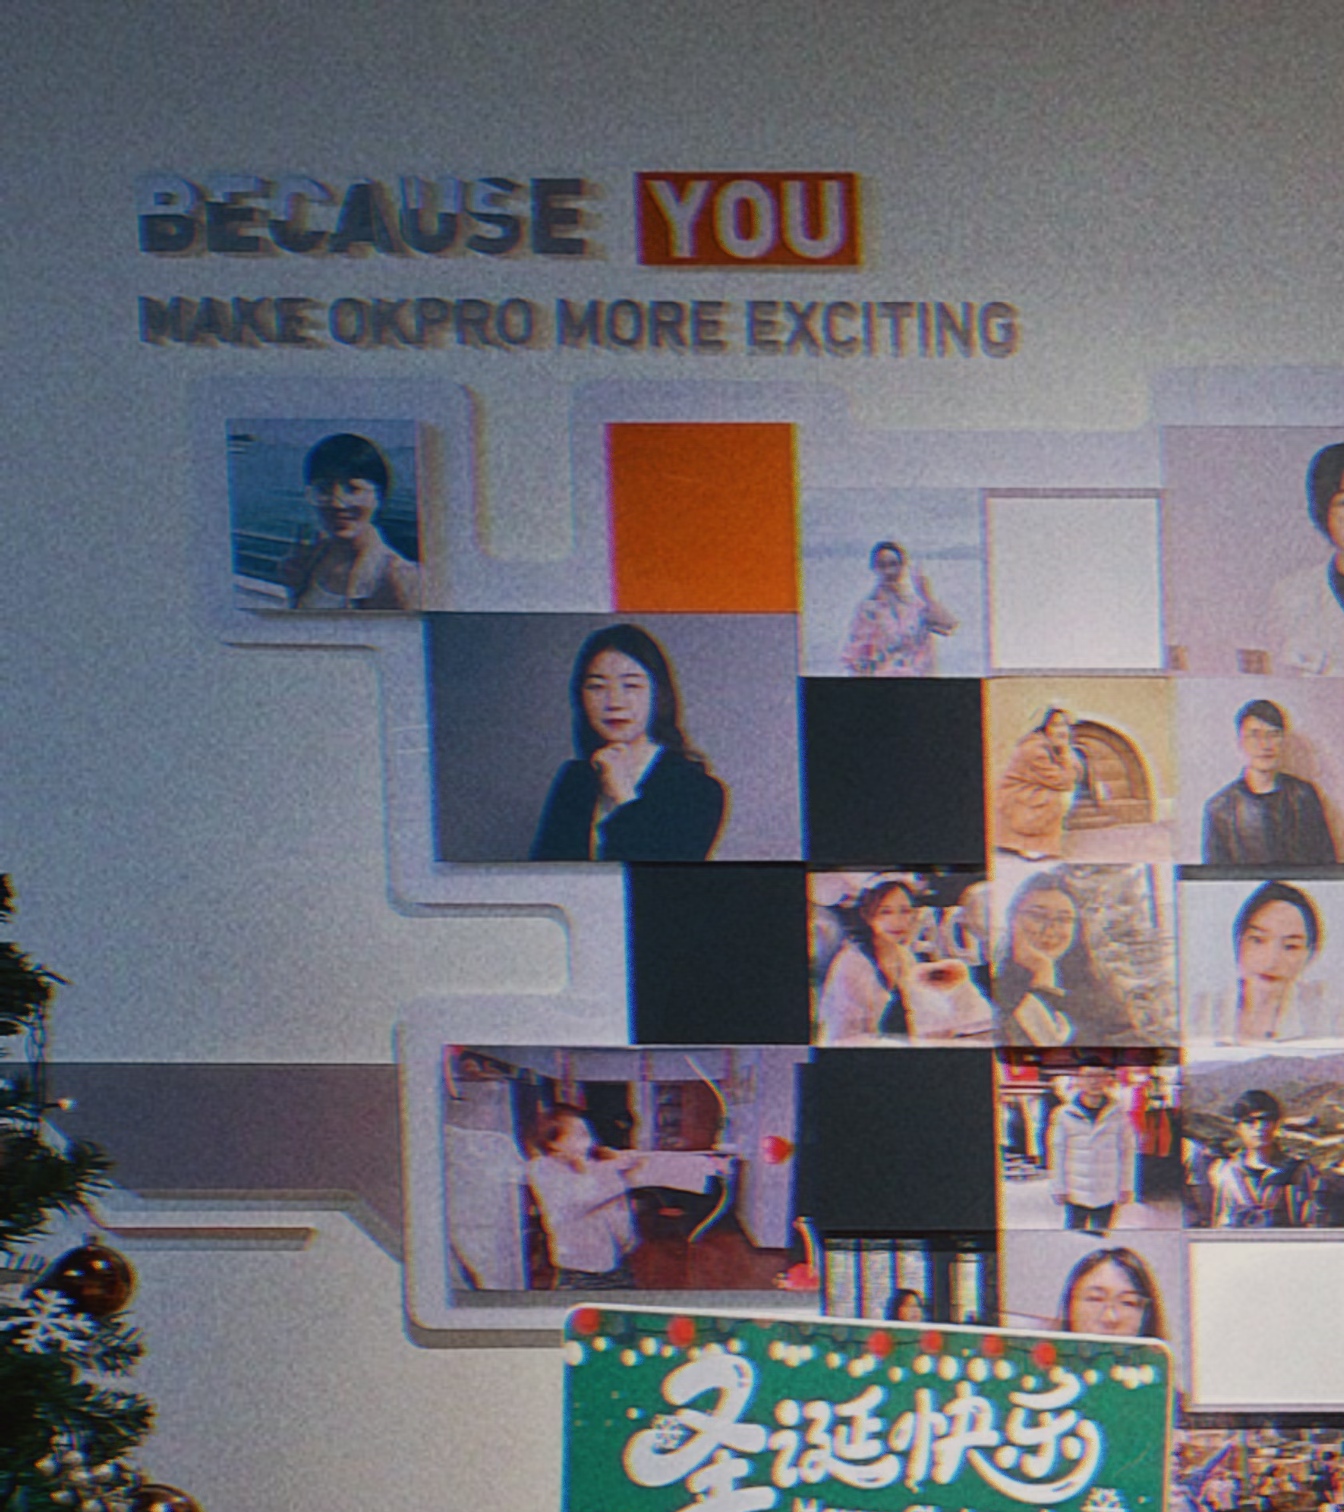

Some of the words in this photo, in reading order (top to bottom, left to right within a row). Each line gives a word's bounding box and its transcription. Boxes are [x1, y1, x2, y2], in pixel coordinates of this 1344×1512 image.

[136, 176, 590, 257] BECAUSE
[650, 180, 844, 259] YOU
[137, 296, 314, 347] MAKE
[328, 298, 535, 349] OKPRO
[555, 299, 727, 352] MORE
[744, 302, 1019, 358] EXCITING
